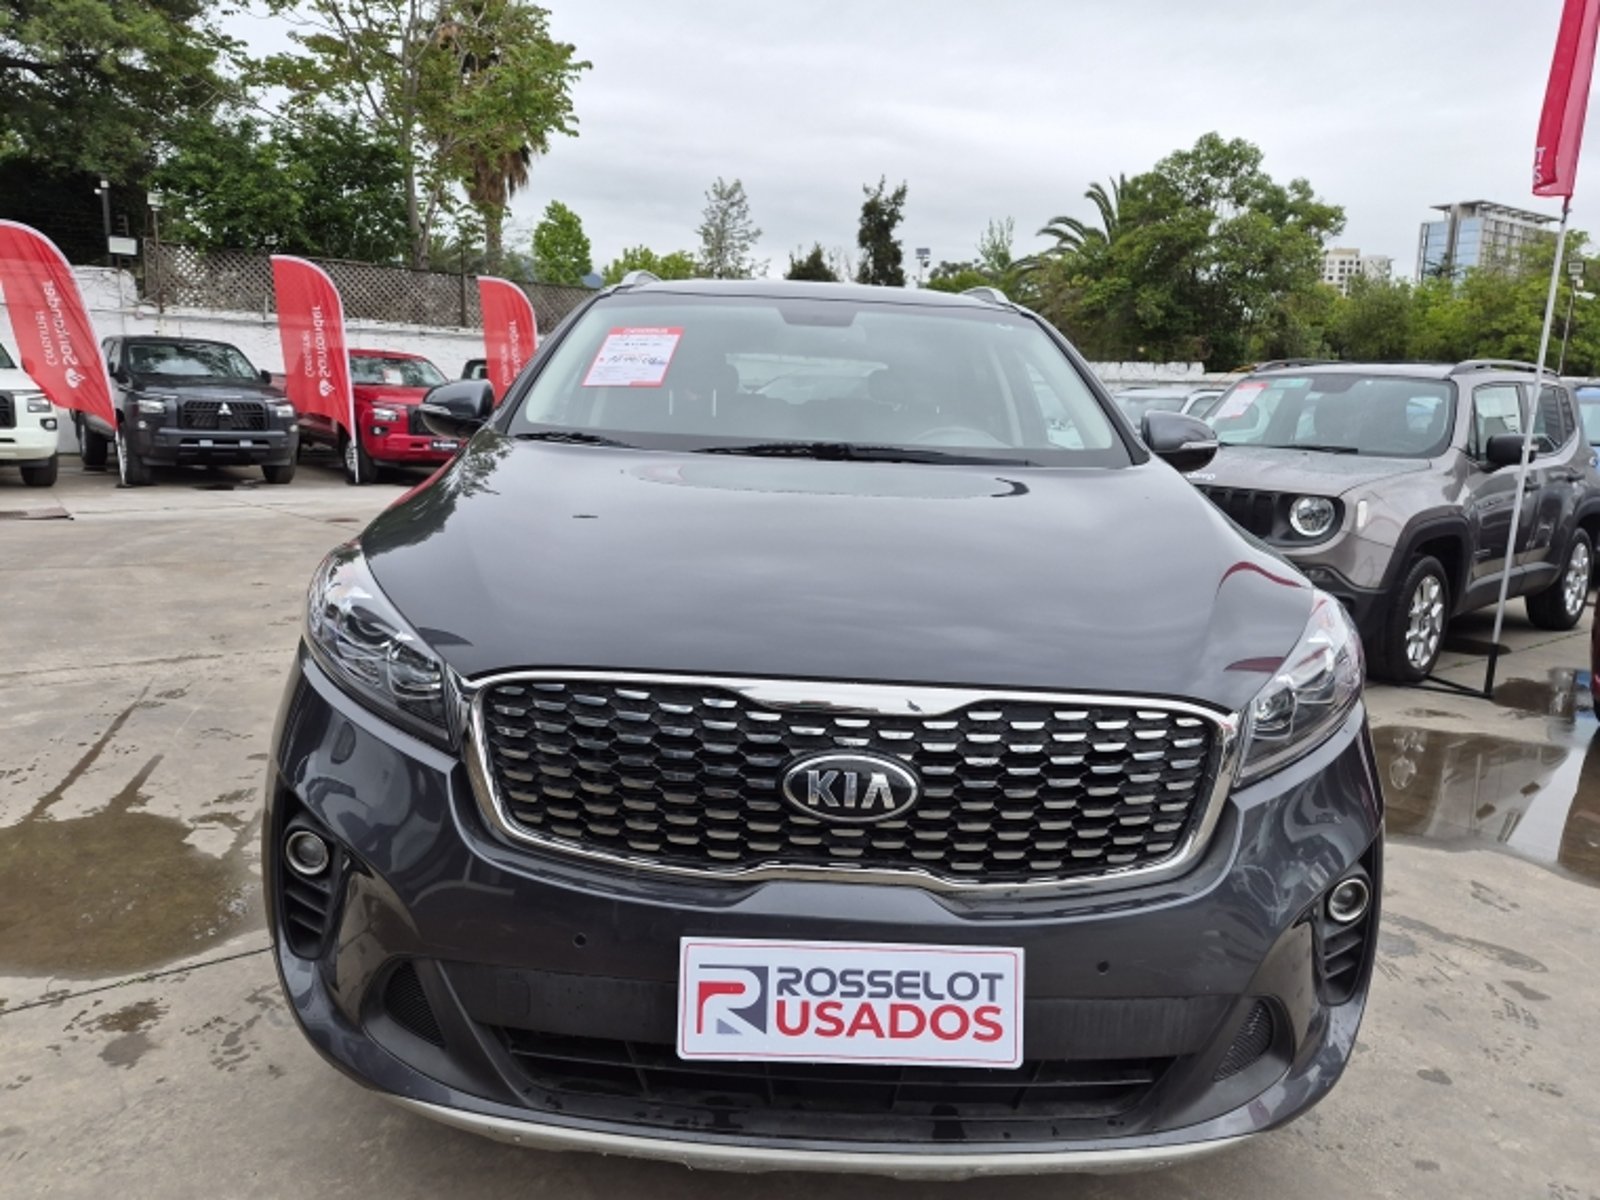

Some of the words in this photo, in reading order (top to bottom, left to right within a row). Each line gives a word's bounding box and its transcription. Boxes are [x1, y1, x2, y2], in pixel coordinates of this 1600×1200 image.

[806, 769, 896, 809] KIA
[776, 966, 1005, 1002] ROSSELOT
[775, 999, 1005, 1042] USADOS
